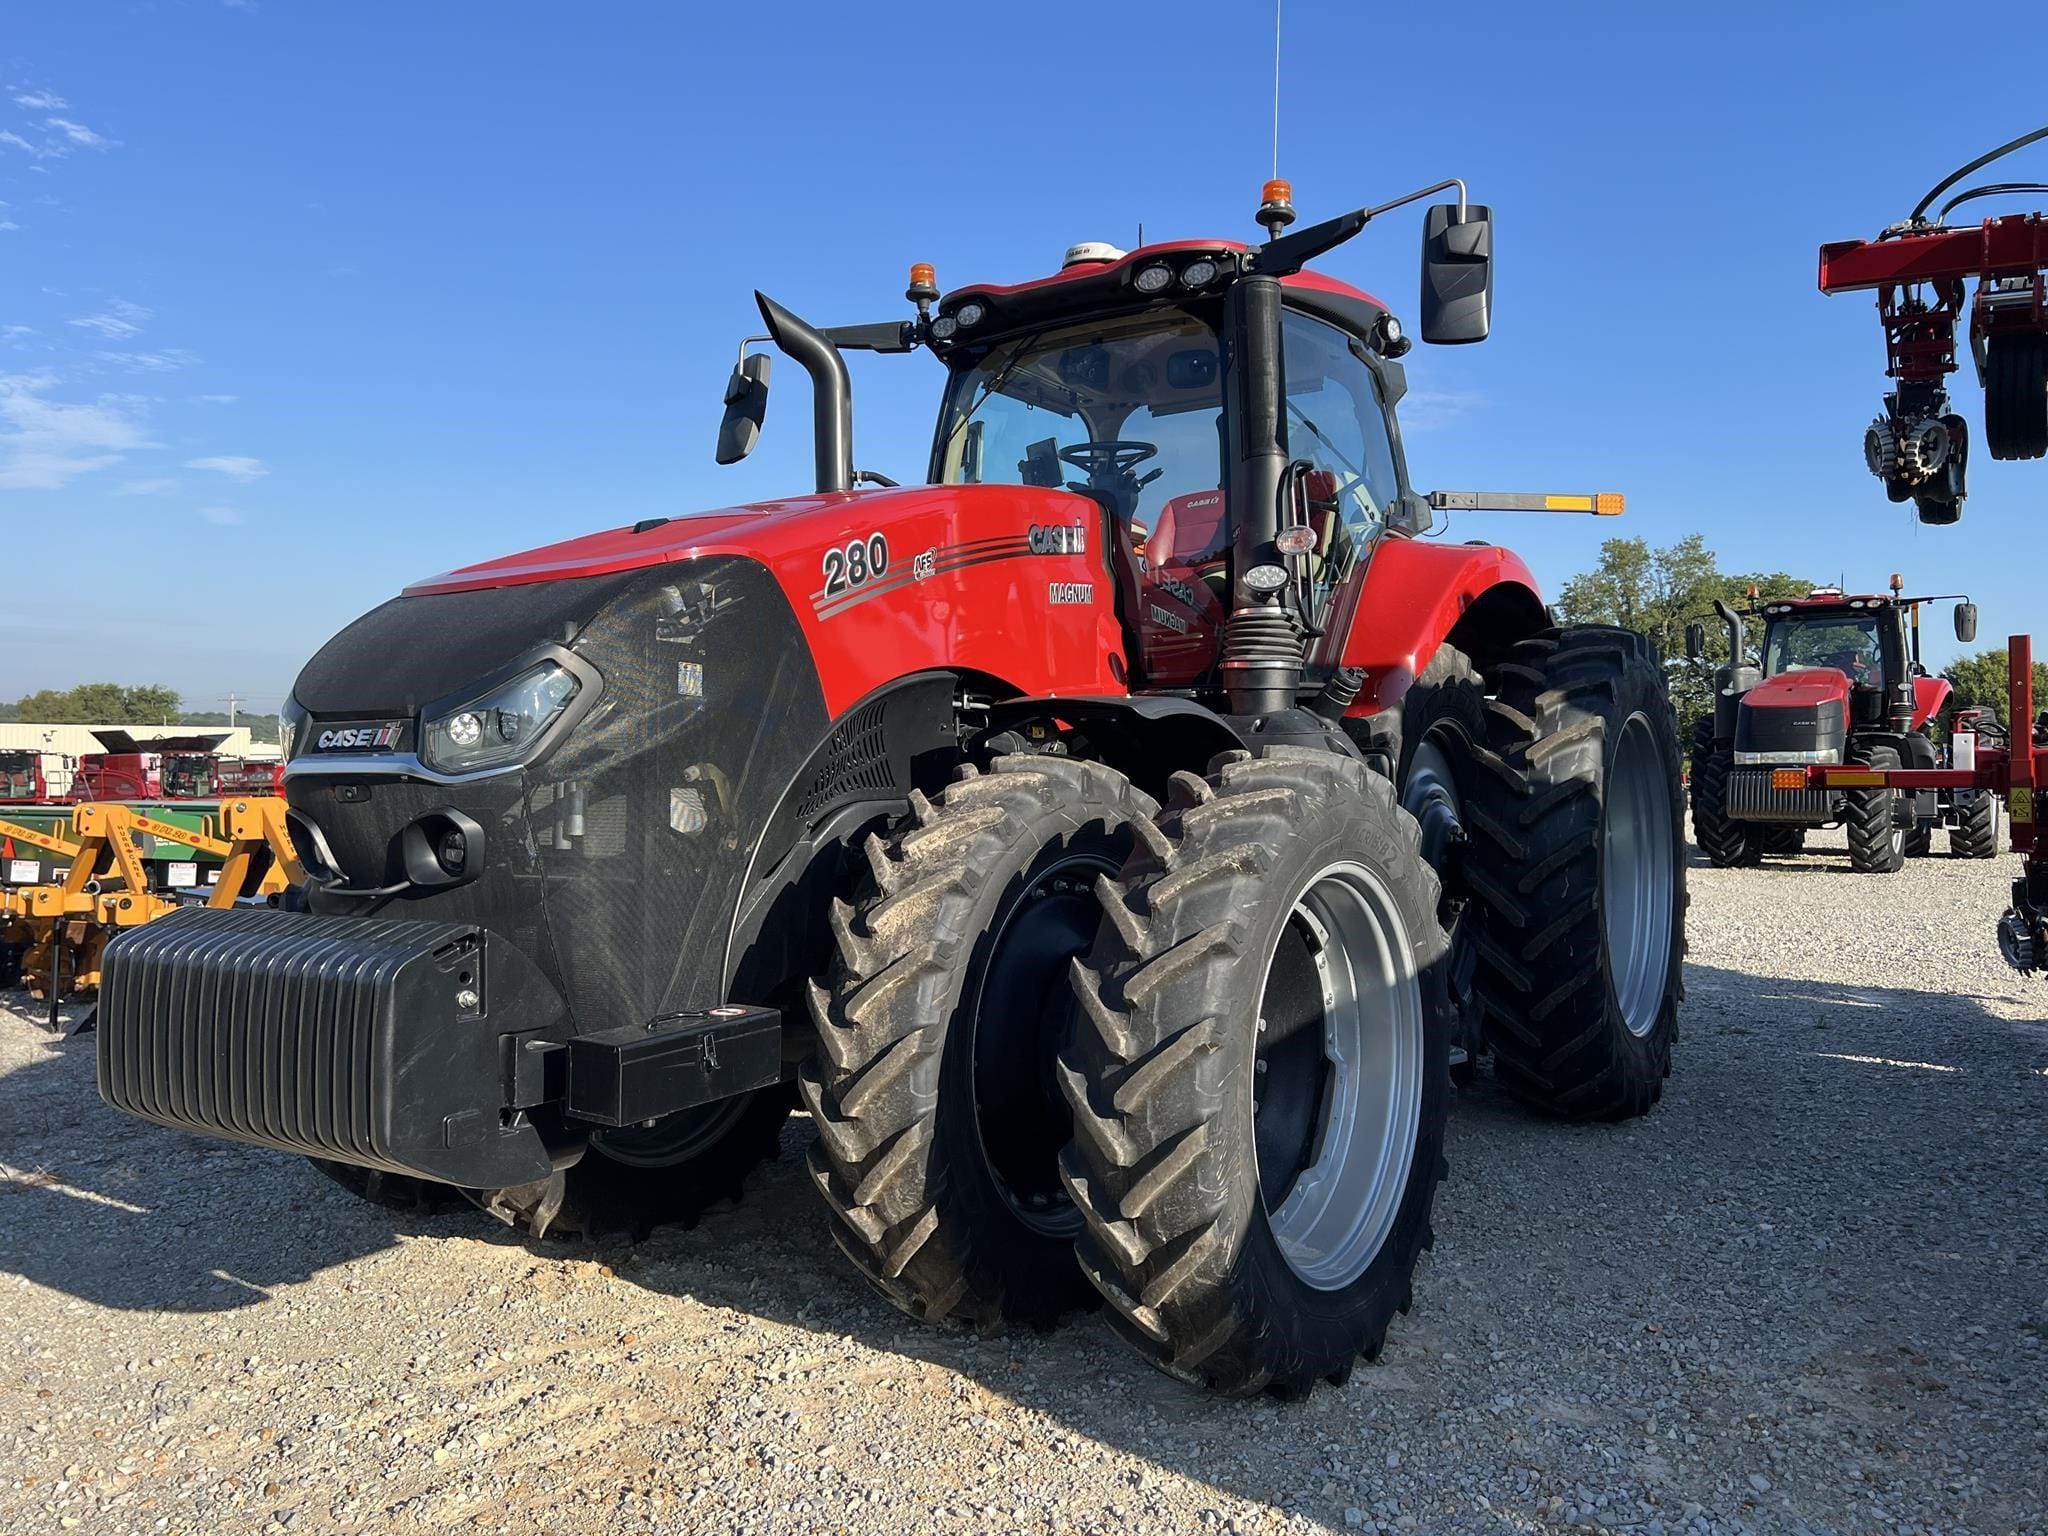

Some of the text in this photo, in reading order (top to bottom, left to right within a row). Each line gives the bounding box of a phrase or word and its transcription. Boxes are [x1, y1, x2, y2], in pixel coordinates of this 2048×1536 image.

[1187, 498, 1211, 508] CASE
[1028, 524, 1073, 554] CASE
[823, 532, 888, 599] 280
[914, 551, 933, 573] AFS
[1049, 582, 1094, 605] MAGNUM
[318, 728, 372, 749] CASE
